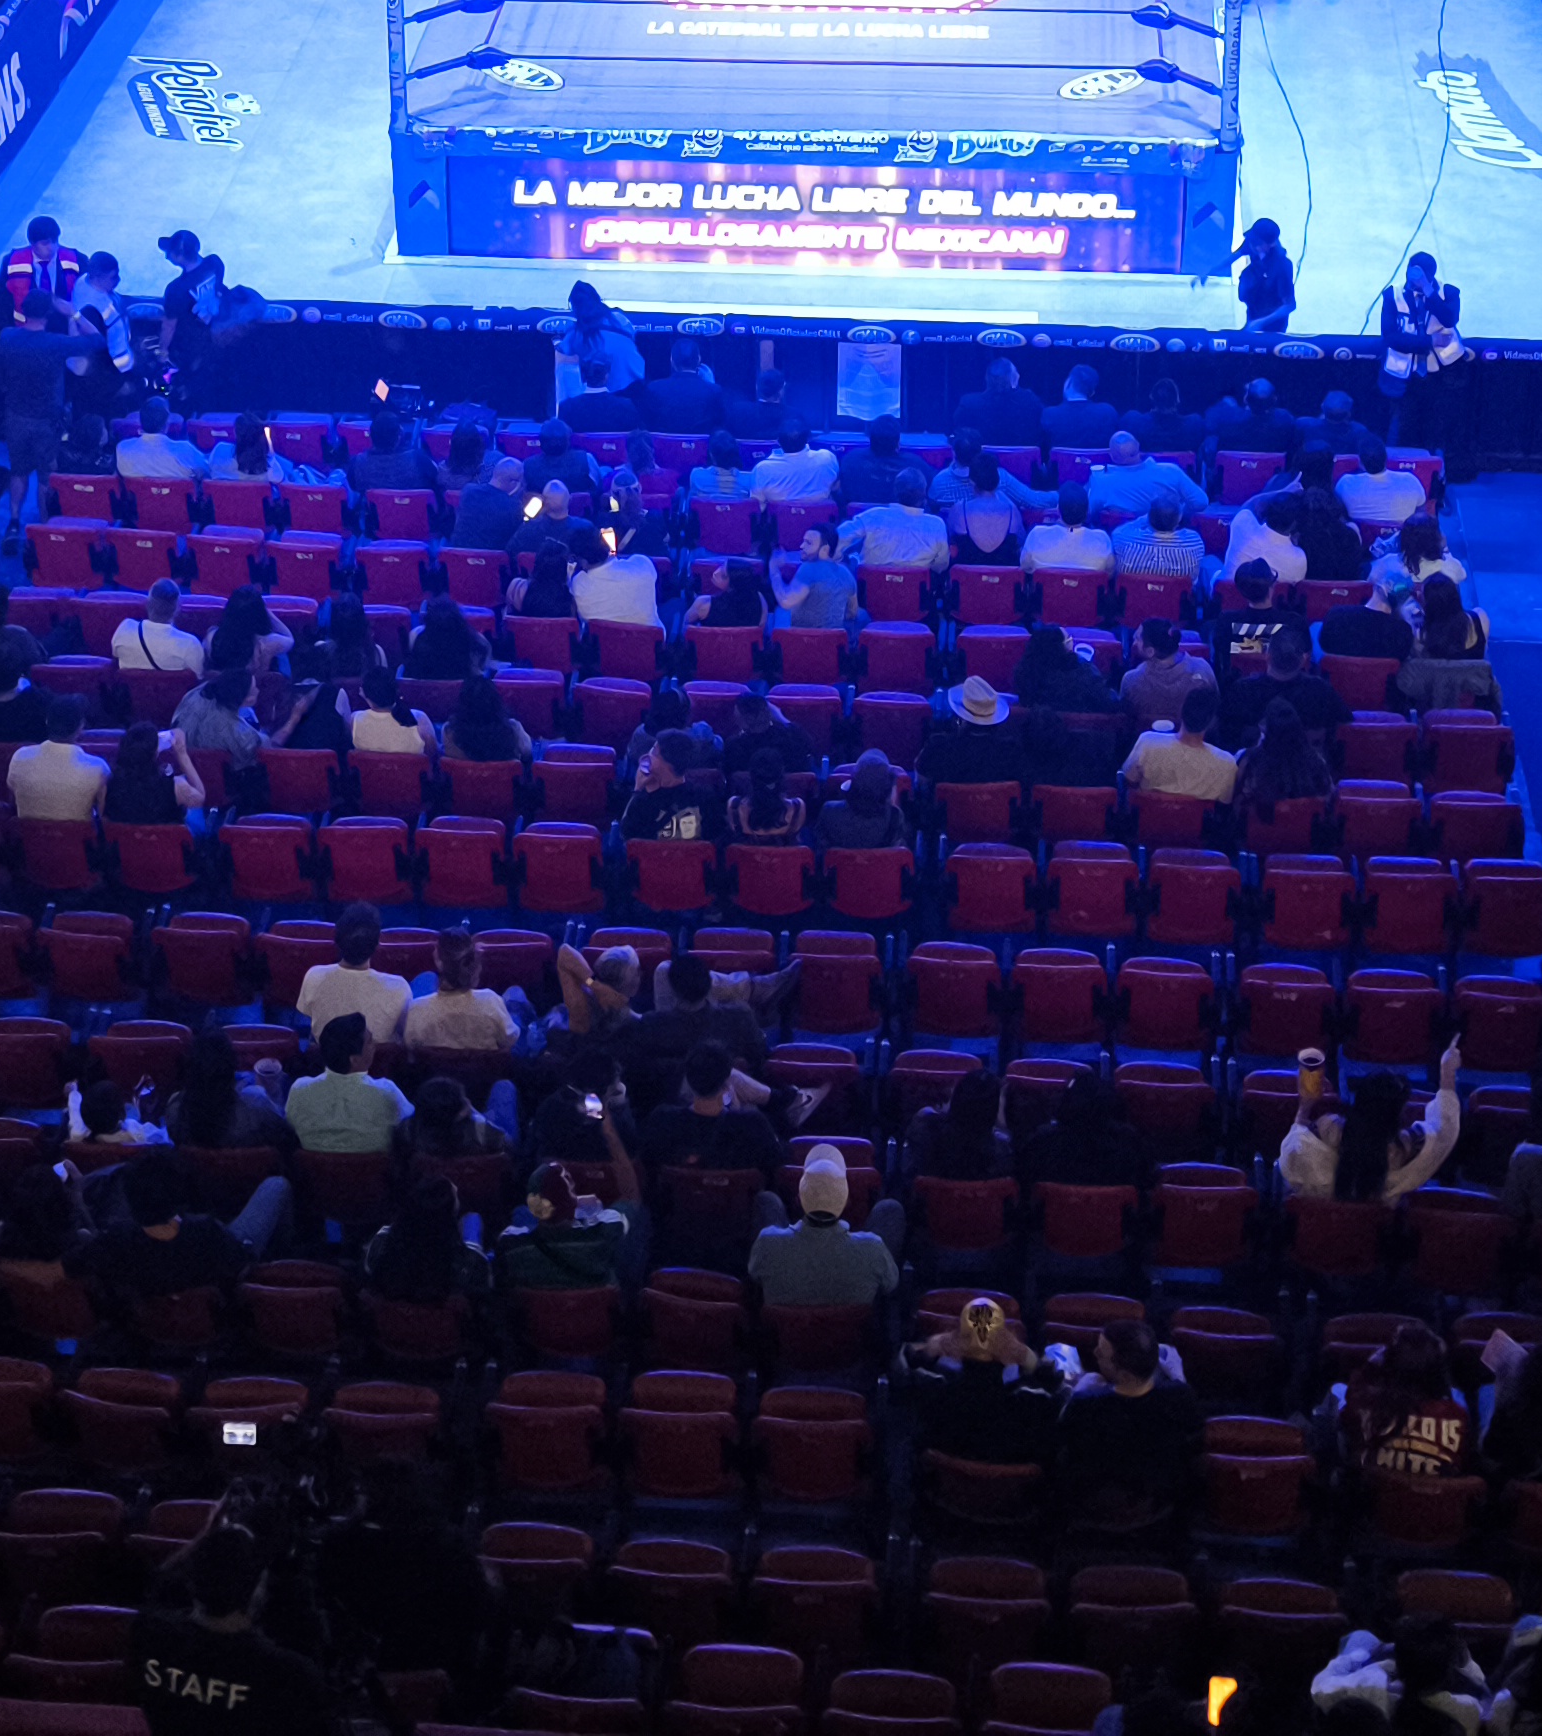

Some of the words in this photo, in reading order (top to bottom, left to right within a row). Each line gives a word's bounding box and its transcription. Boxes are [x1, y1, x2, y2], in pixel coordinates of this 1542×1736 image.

[647, 21, 675, 35] LA
[822, 23, 850, 37] LA
[854, 23, 924, 38] LUCHA
[928, 24, 989, 39] LIBRE
[127, 55, 245, 152] Peñafiel
[798, 130, 889, 144] Celebrando
[513, 178, 557, 205] LA
[567, 180, 683, 209] MEJOR
[692, 183, 801, 212] LUCHA
[811, 186, 909, 215] LIBRE
[917, 189, 981, 217] DEL
[144, 1659, 251, 1710] STAFF
